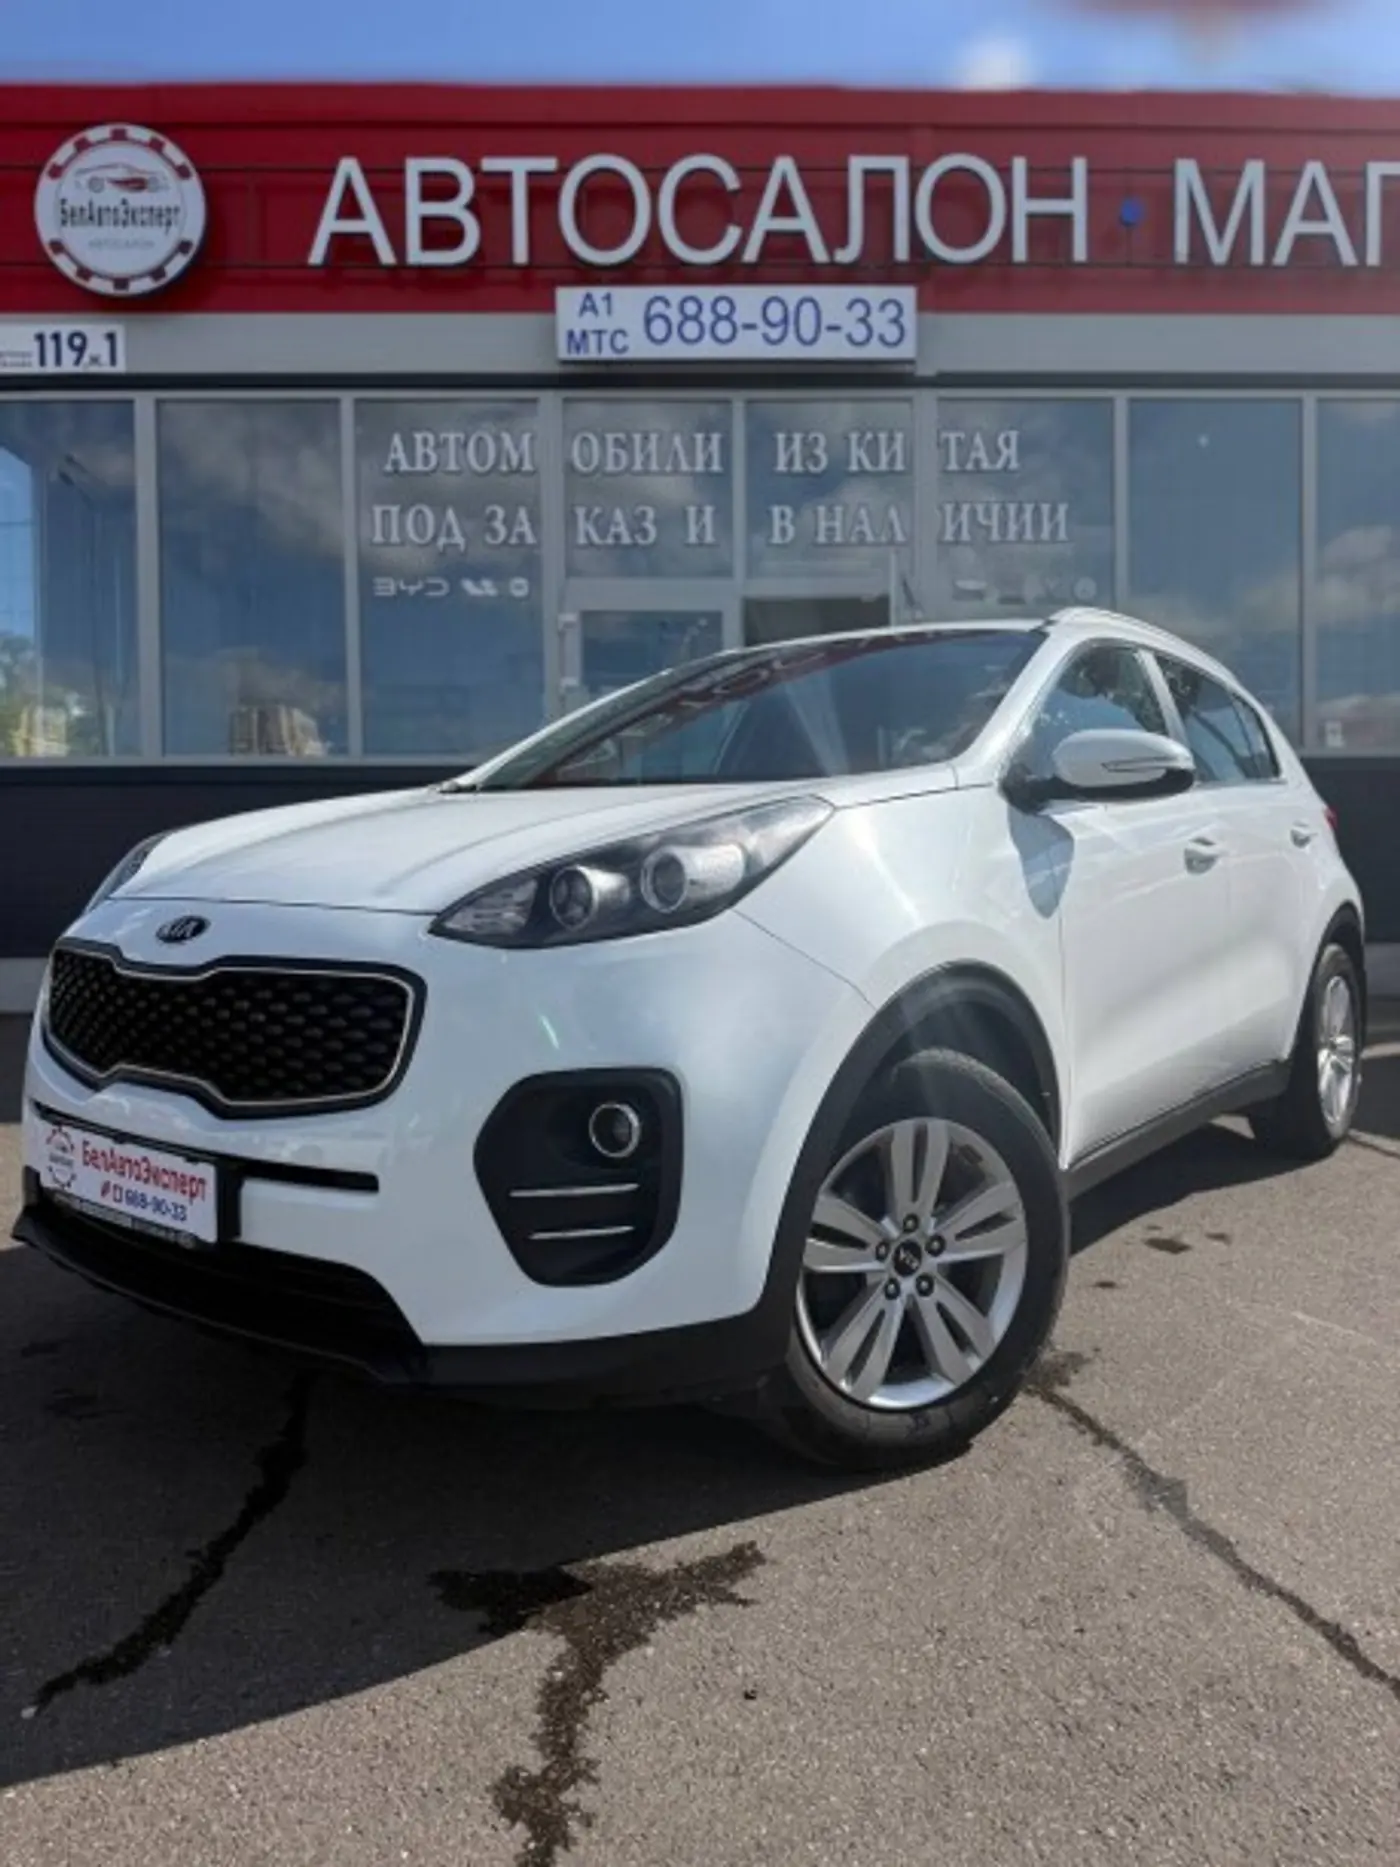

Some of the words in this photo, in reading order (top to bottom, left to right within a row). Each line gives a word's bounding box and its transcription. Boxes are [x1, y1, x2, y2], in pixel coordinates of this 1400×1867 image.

[307, 154, 1089, 266] АВТОСАЛОН
[578, 292, 614, 318] A1
[643, 295, 906, 348] 688-90-33
[566, 329, 630, 355] МТС
[774, 431, 829, 473] ИЗ
[372, 503, 466, 552] ПОД
[685, 504, 717, 545] И
[770, 504, 796, 545] В
[373, 576, 450, 597] BYD
